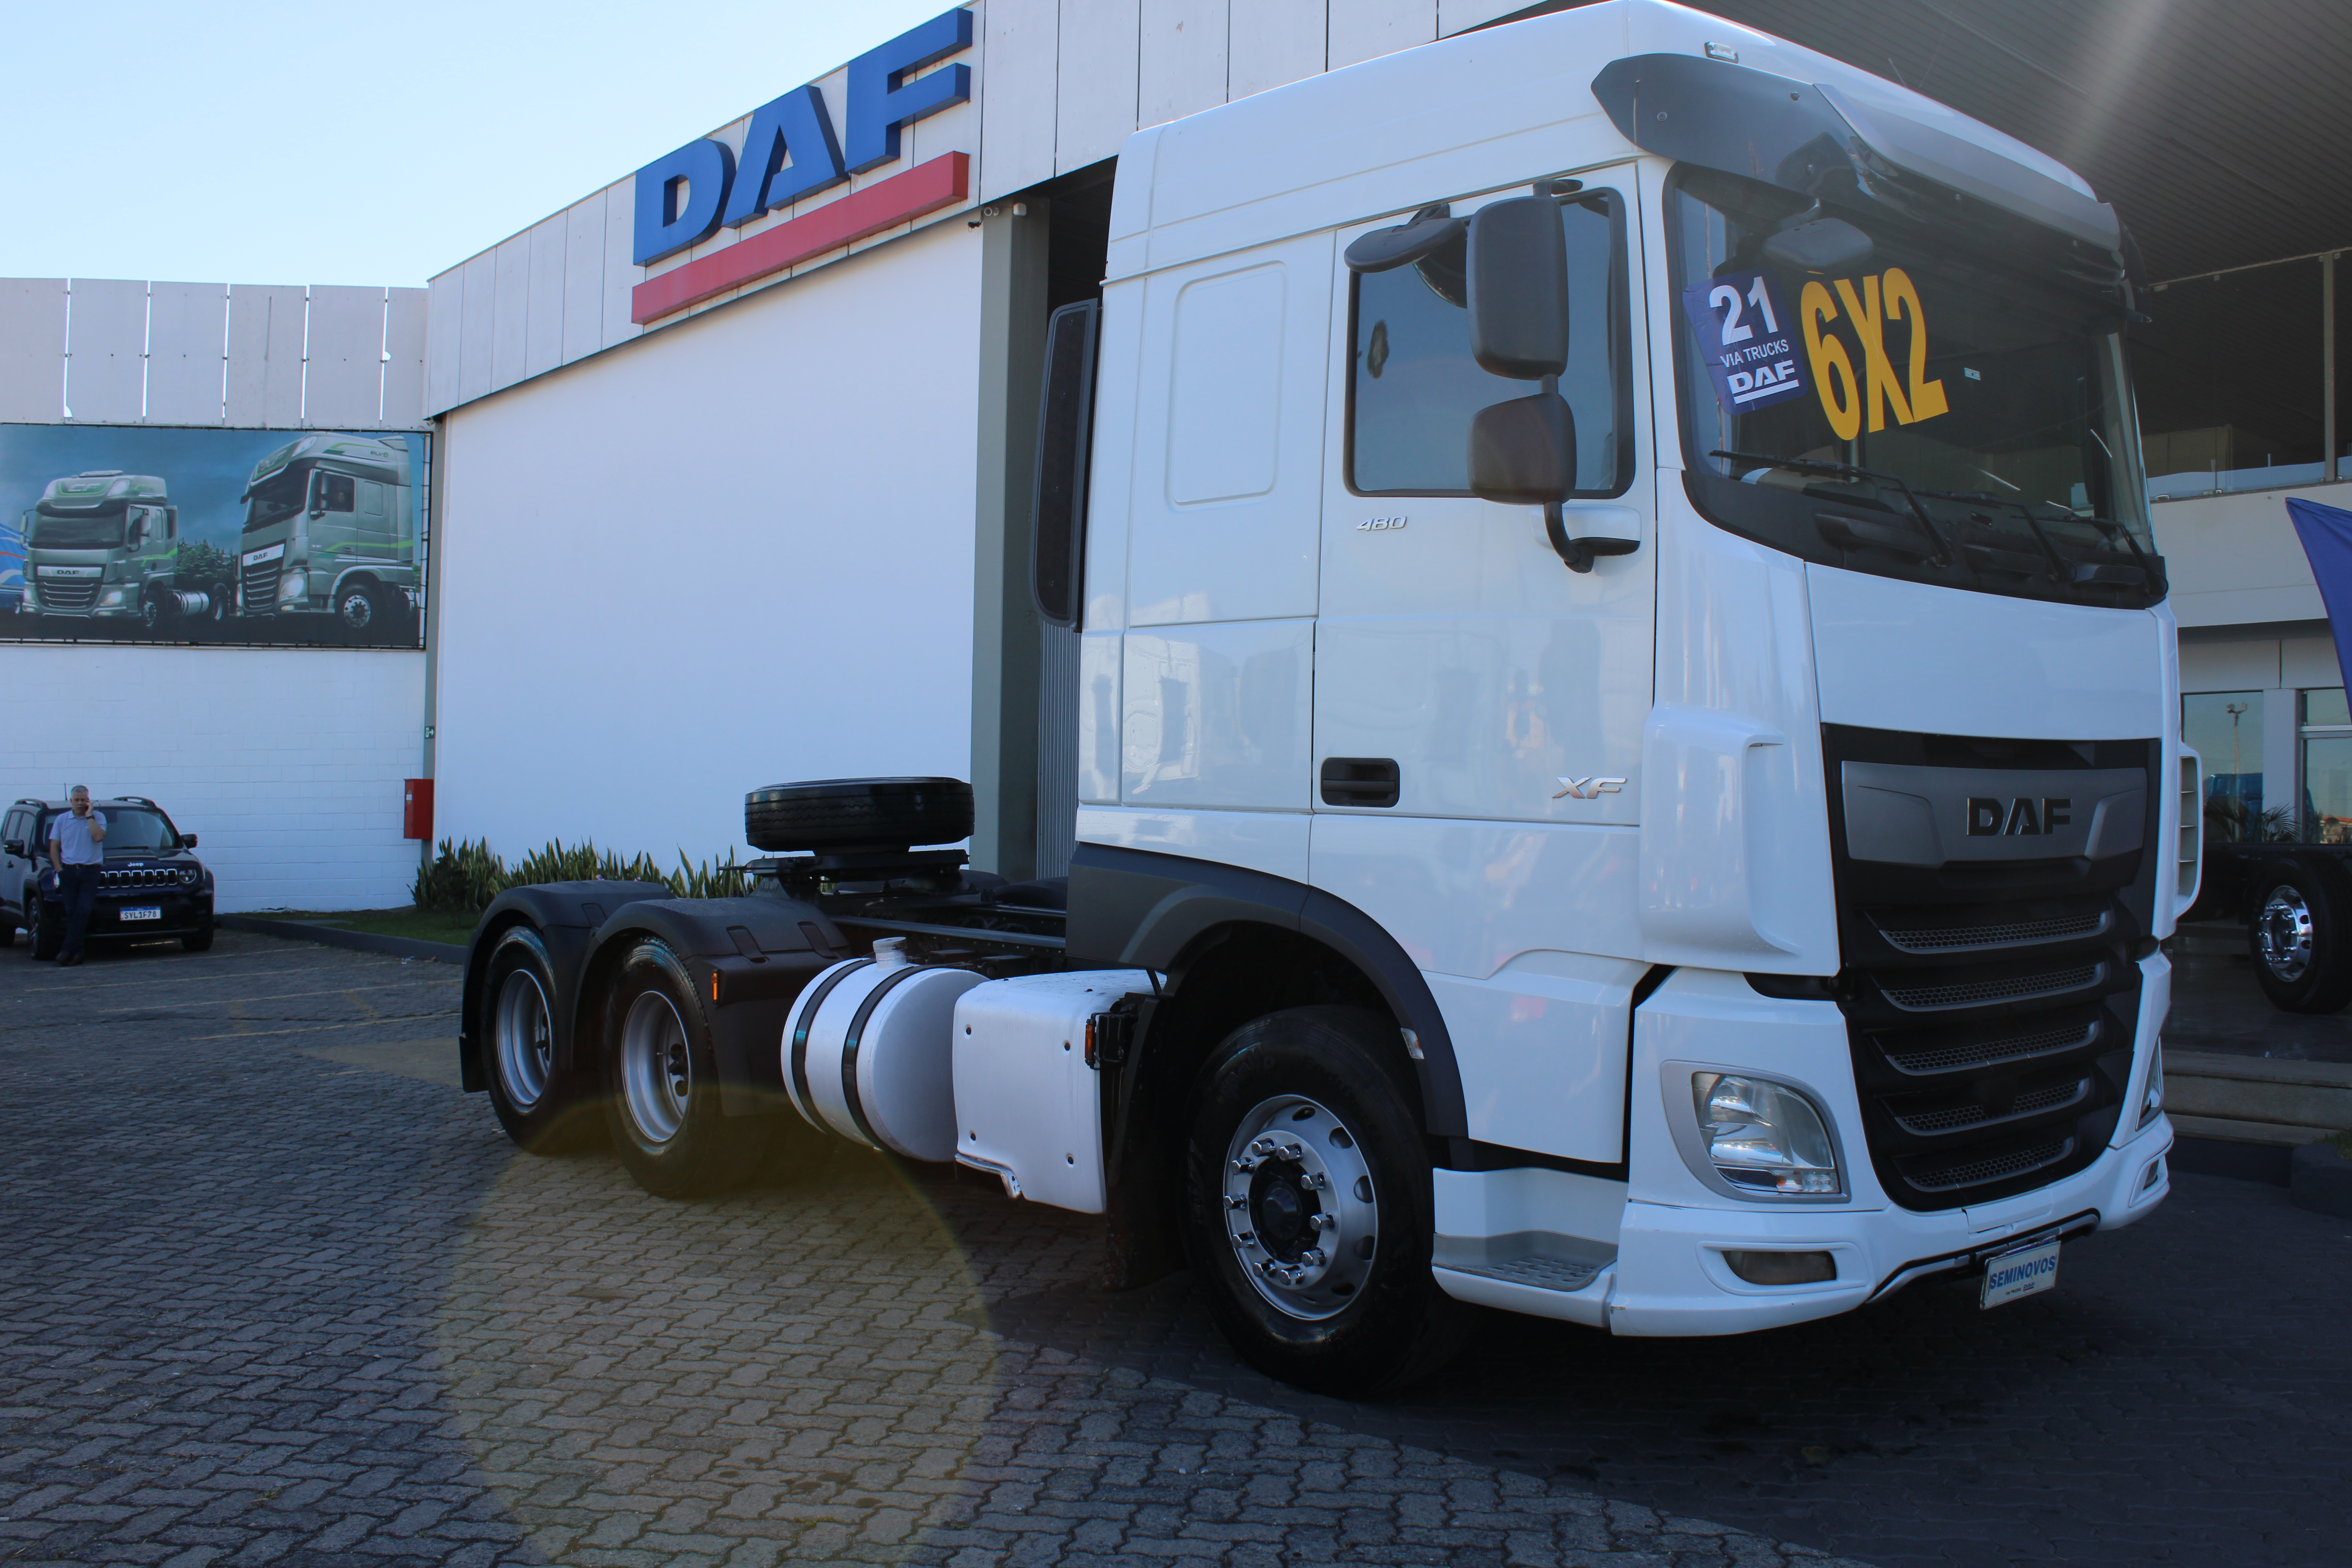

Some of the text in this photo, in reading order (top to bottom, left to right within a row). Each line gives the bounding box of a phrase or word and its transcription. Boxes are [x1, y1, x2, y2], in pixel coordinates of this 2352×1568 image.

[633, 8, 973, 266] DAF
[1709, 276, 1779, 346] 21
[1720, 339, 1789, 368] VIA TRUCKS
[1800, 267, 1949, 441] 6X2
[1726, 359, 1795, 394] DAF
[67, 483, 100, 492] CF
[1356, 516, 1408, 532] 480
[253, 552, 268, 561] DAF
[1552, 777, 1628, 799] XF
[1967, 797, 2072, 837] DAF
[124, 911, 157, 919] SYL1F78
[1990, 1255, 2056, 1290] SEMINOVOS
